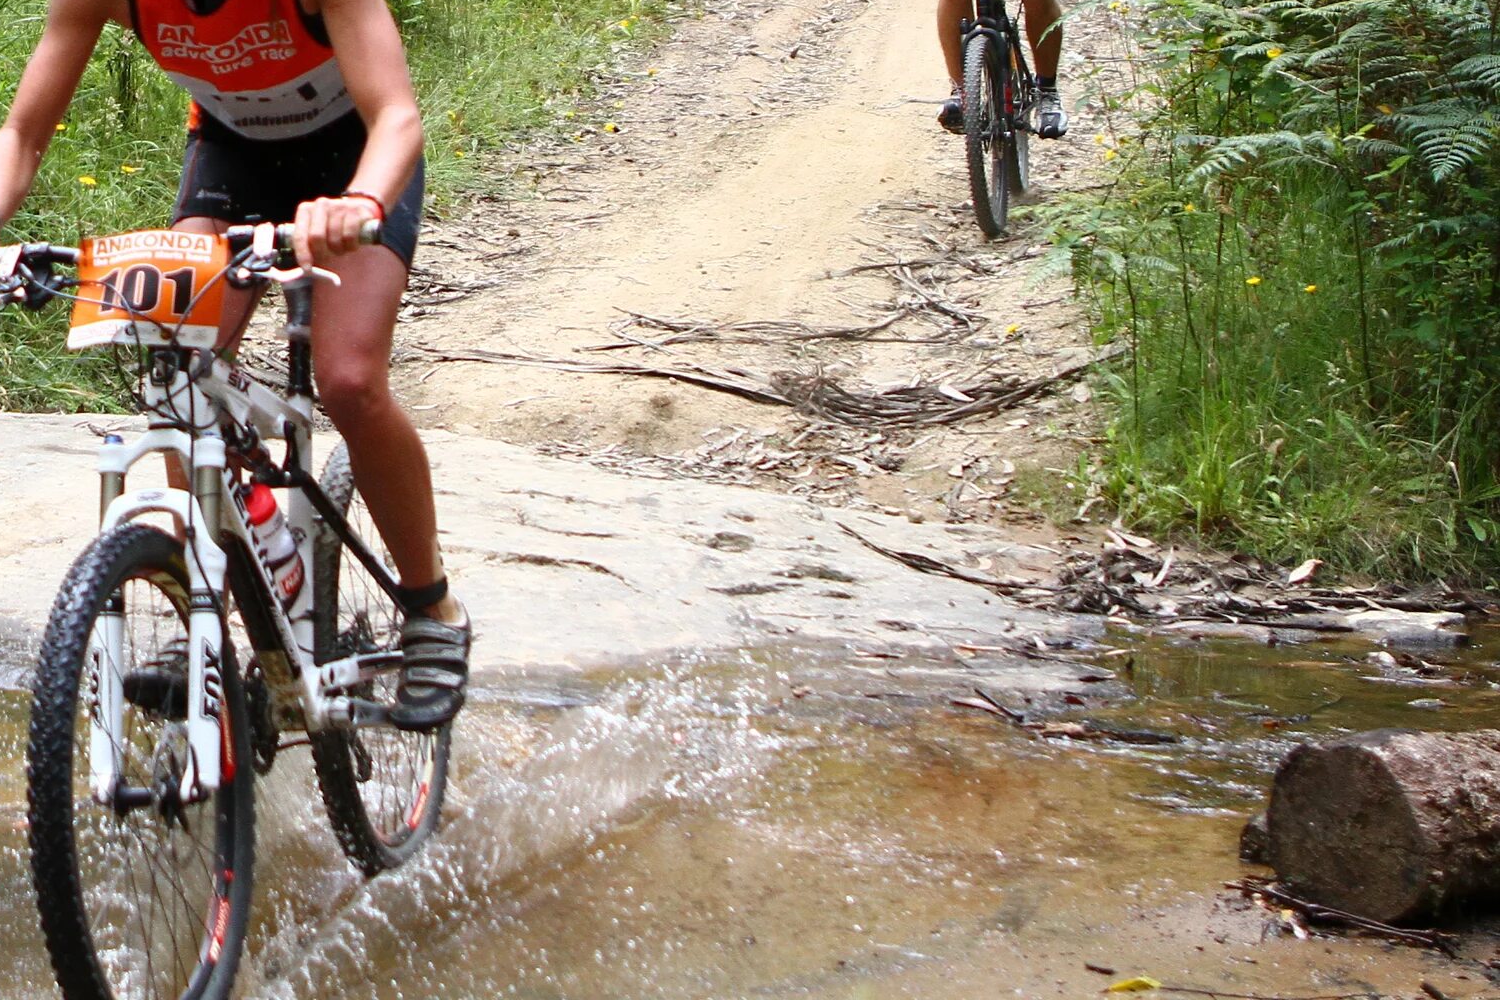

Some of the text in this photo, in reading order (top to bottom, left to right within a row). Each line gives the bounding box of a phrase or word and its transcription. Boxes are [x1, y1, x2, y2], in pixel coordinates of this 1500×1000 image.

[159, 22, 292, 62] ANONDA
[95, 234, 208, 256] ANACONDA
[98, 263, 197, 317] 101
[203, 642, 222, 720] FOX
